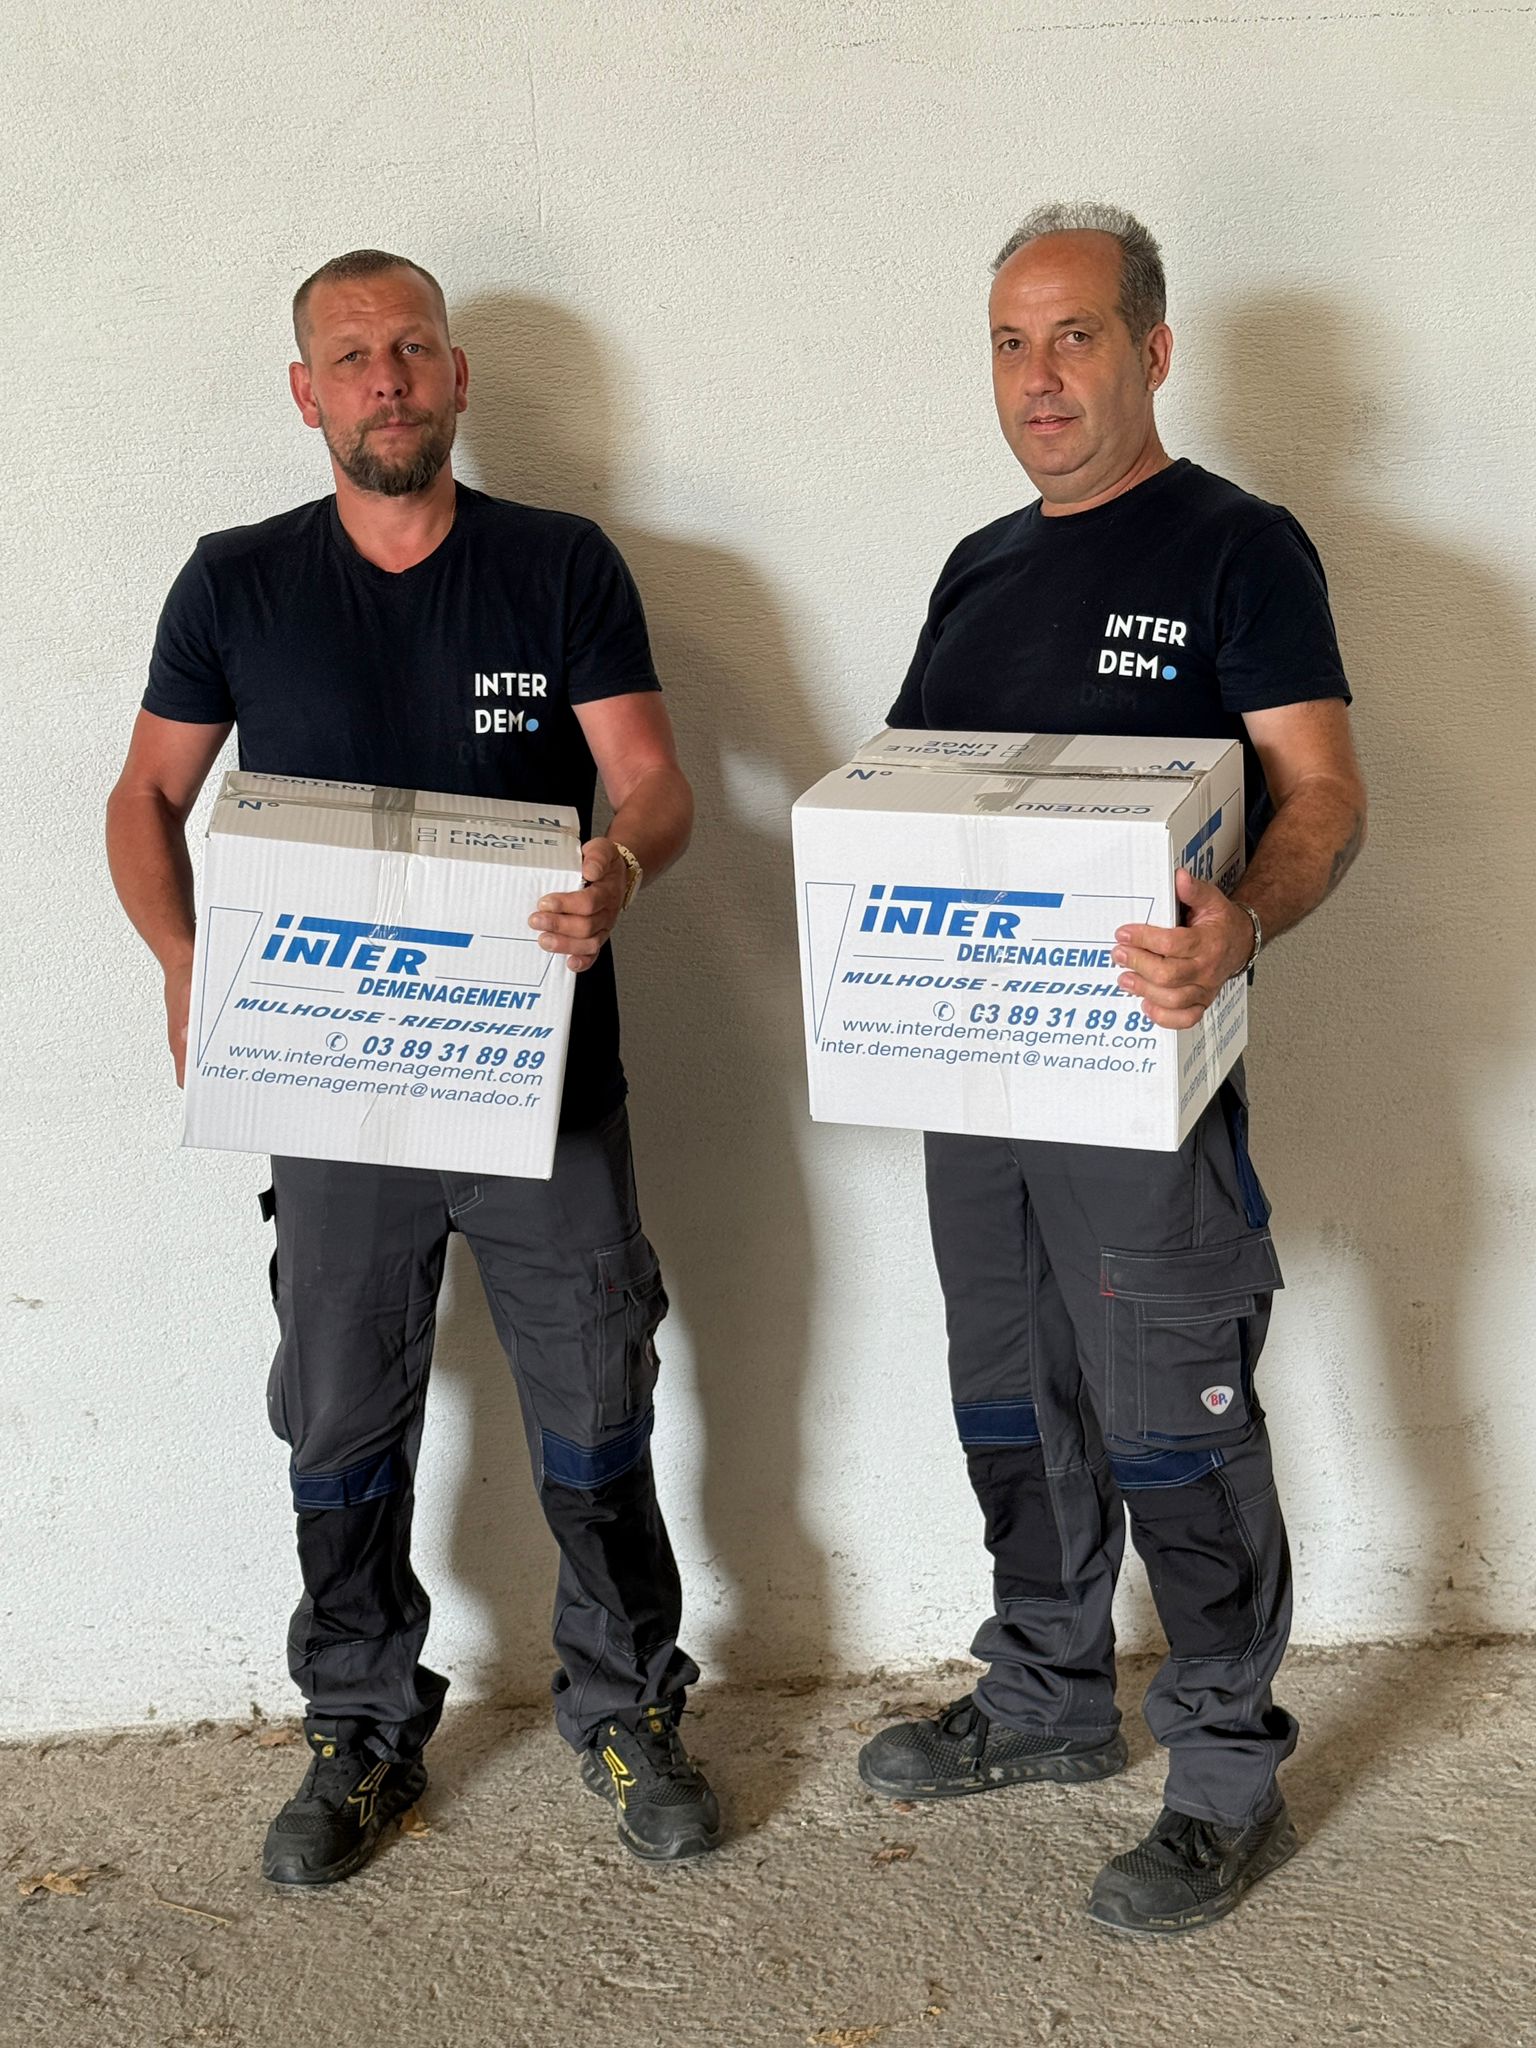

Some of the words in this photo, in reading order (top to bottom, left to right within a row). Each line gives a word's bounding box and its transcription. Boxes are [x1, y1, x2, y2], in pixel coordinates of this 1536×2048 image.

[1104, 614, 1187, 647] INTER
[475, 672, 547, 697] INTER
[882, 745, 989, 758] FRAGILE
[923, 740, 998, 751] LINGE
[253, 774, 376, 792] CONTENU
[1015, 804, 1151, 814] CONTENU
[450, 837, 526, 850] LINGE
[451, 829, 559, 846] FRAGILE
[957, 944, 1125, 969] DEMENAGEME
[357, 977, 542, 1010] DEMENAGEMENT
[841, 971, 987, 992] MULHOUSE
[1002, 979, 1145, 998] RIEDISHE
[234, 998, 385, 1024] MULHOUSE
[398, 1015, 555, 1039] RIEDISHEIM
[969, 1003, 1000, 1023] 03
[1007, 1005, 1039, 1026] 89
[1045, 1008, 1077, 1028] 31
[1085, 1009, 1117, 1030] 89
[842, 1019, 1157, 1050] www.interdemenagement.com
[228, 1044, 543, 1086] www.interdemenagement.com
[362, 1036, 393, 1057] 03
[400, 1039, 433, 1060] 89
[438, 1043, 470, 1064] 31
[475, 1047, 507, 1067] 89
[513, 1050, 546, 1070] 89
[820, 1037, 1157, 1074] inter.demenagement@wanadoo.fr
[201, 1064, 542, 1108] inter.demenagement@wanadoo.fr
